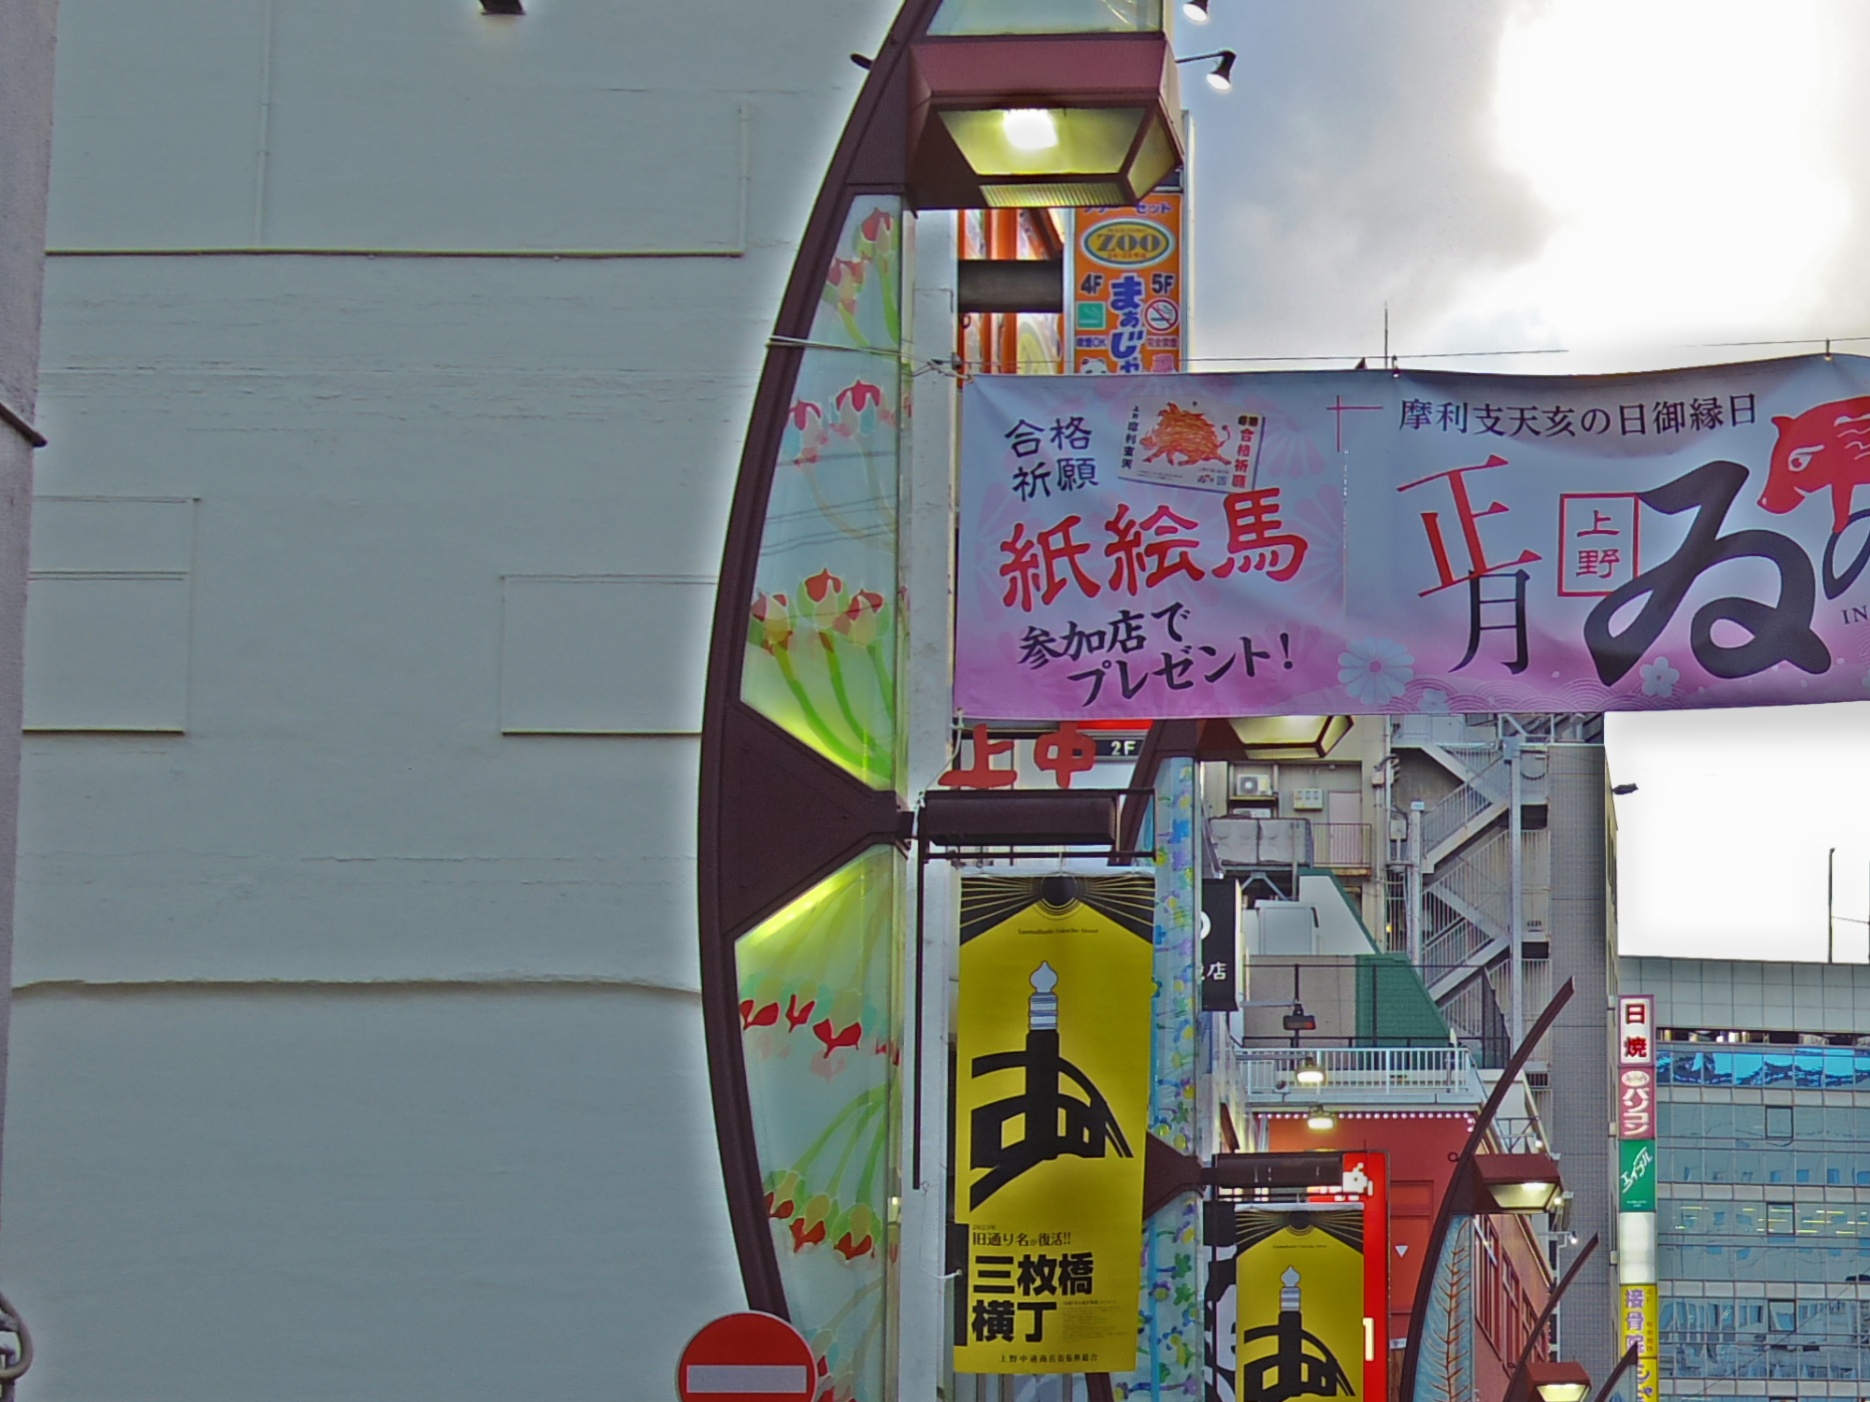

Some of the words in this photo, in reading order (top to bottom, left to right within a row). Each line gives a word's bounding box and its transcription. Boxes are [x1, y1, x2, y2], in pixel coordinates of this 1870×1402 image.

[1096, 233, 1161, 253] ZOO
[1080, 274, 1104, 294] 4F
[1151, 273, 1175, 294] 5F
[1004, 415, 1093, 458] 合格
[1398, 392, 1759, 438] 摩利支天亥の日御縁日
[1012, 456, 1099, 502] 祈願
[1000, 489, 1309, 613] 紙絵馬
[1576, 509, 1621, 579] 上野
[1017, 601, 1190, 673] 参加店で
[1067, 631, 1293, 707] プレゼント!
[1110, 740, 1135, 756] 2F
[1624, 1003, 1647, 1058] 日焼
[973, 1252, 1094, 1297] 三枚橋
[971, 1299, 1058, 1343] 横丁
